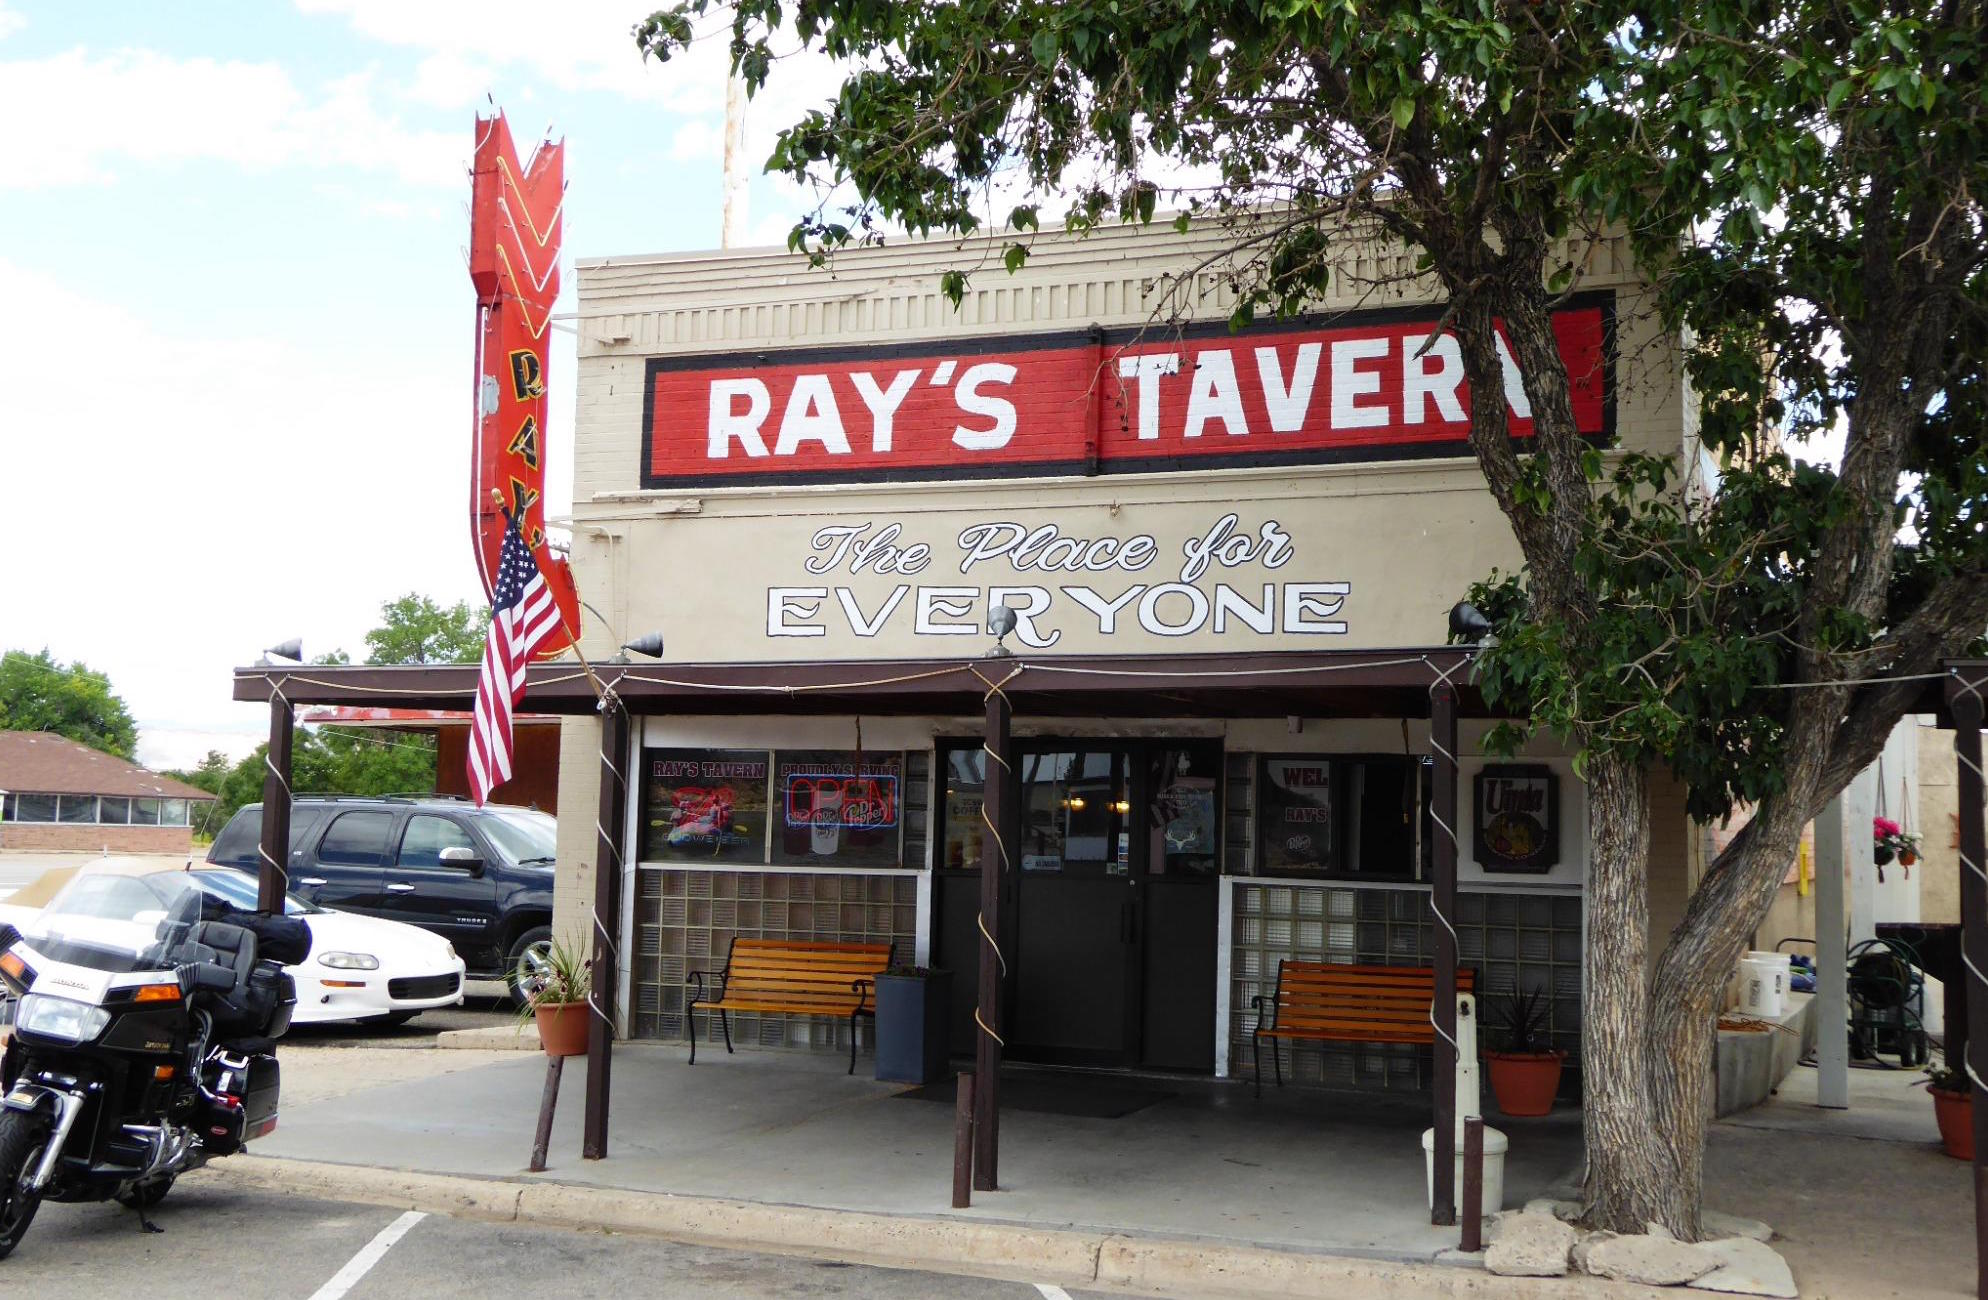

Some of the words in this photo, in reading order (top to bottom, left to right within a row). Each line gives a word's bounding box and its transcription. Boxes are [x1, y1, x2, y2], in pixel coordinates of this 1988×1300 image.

[707, 360, 1018, 459] RAY'S
[508, 348, 546, 550] RAY'
[804, 521, 932, 575] The
[957, 521, 1158, 573] Place
[1178, 512, 1294, 583] for
[766, 582, 1351, 648] EVERYONE
[653, 760, 699, 777] RAY'S
[701, 761, 766, 779] TAVERN
[790, 778, 894, 823] OPEN
[1283, 767, 1328, 787] WEL
